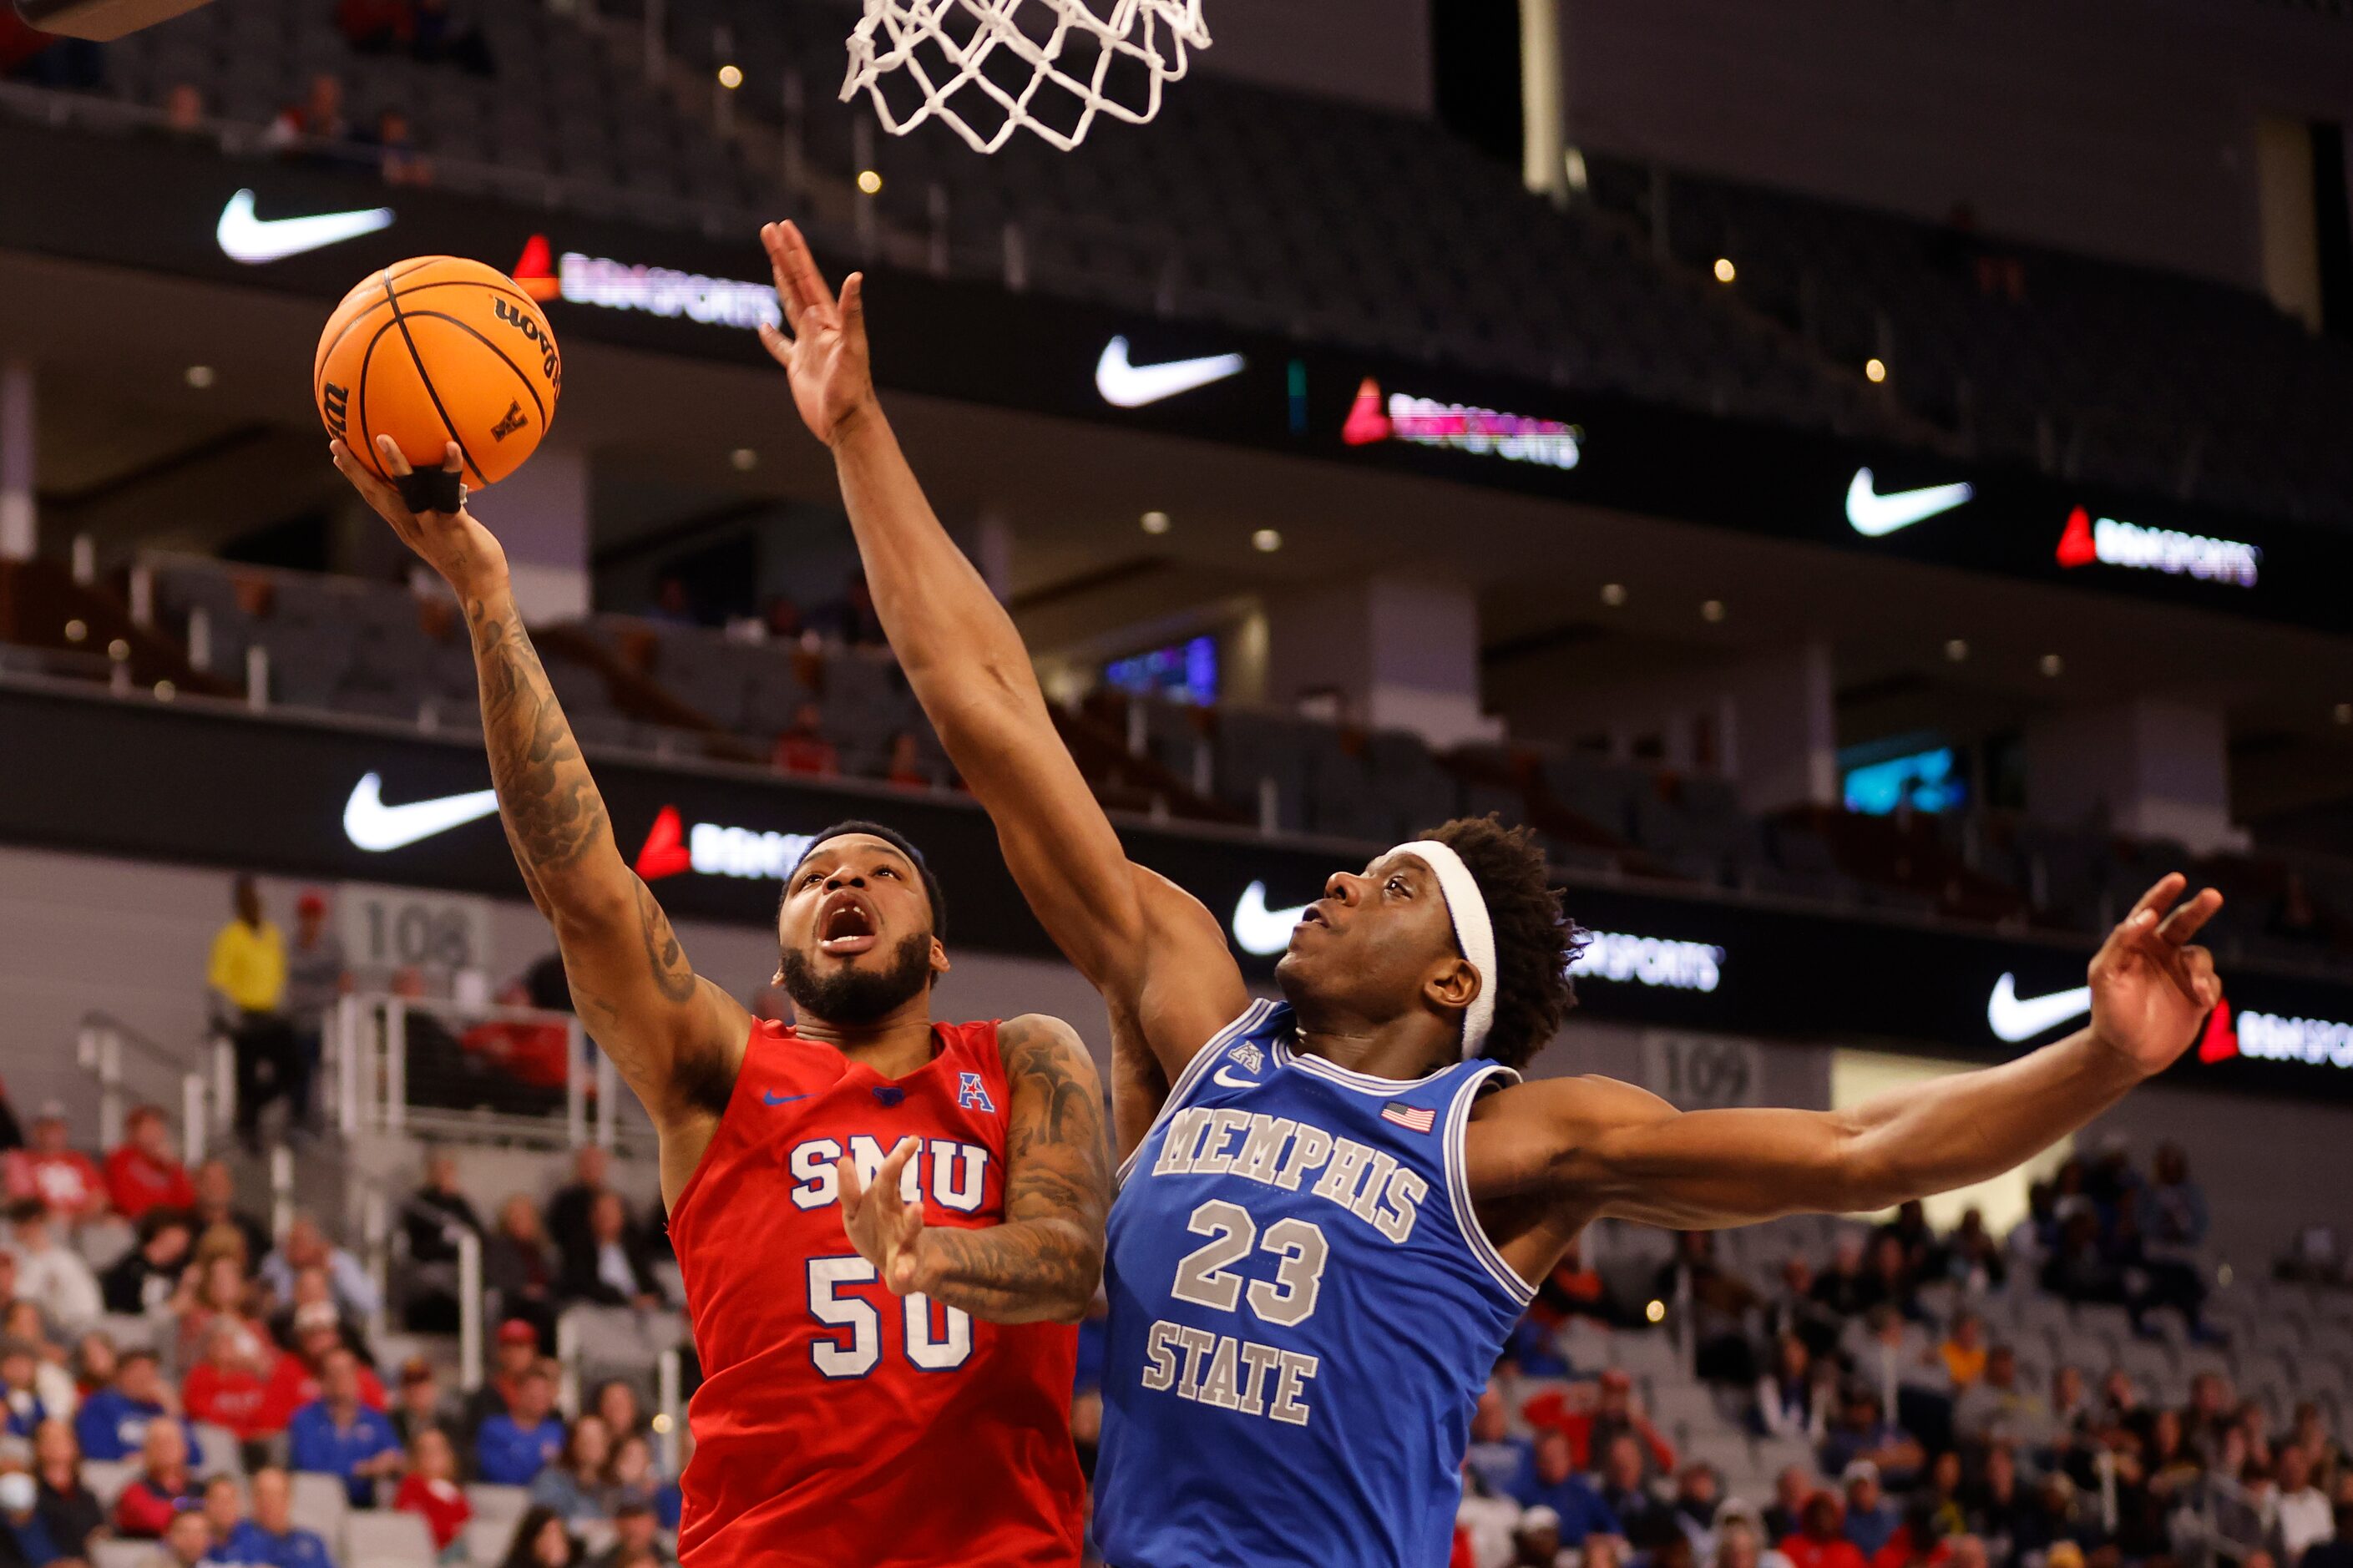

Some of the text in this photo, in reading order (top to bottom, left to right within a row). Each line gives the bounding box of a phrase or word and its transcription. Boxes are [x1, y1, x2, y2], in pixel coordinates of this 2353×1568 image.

[789, 1135, 989, 1213] SMU
[1152, 1106, 1430, 1244] MEMPHIS
[805, 1254, 974, 1380] 50
[1171, 1198, 1329, 1328] 23
[1141, 1319, 1319, 1426] STATE
